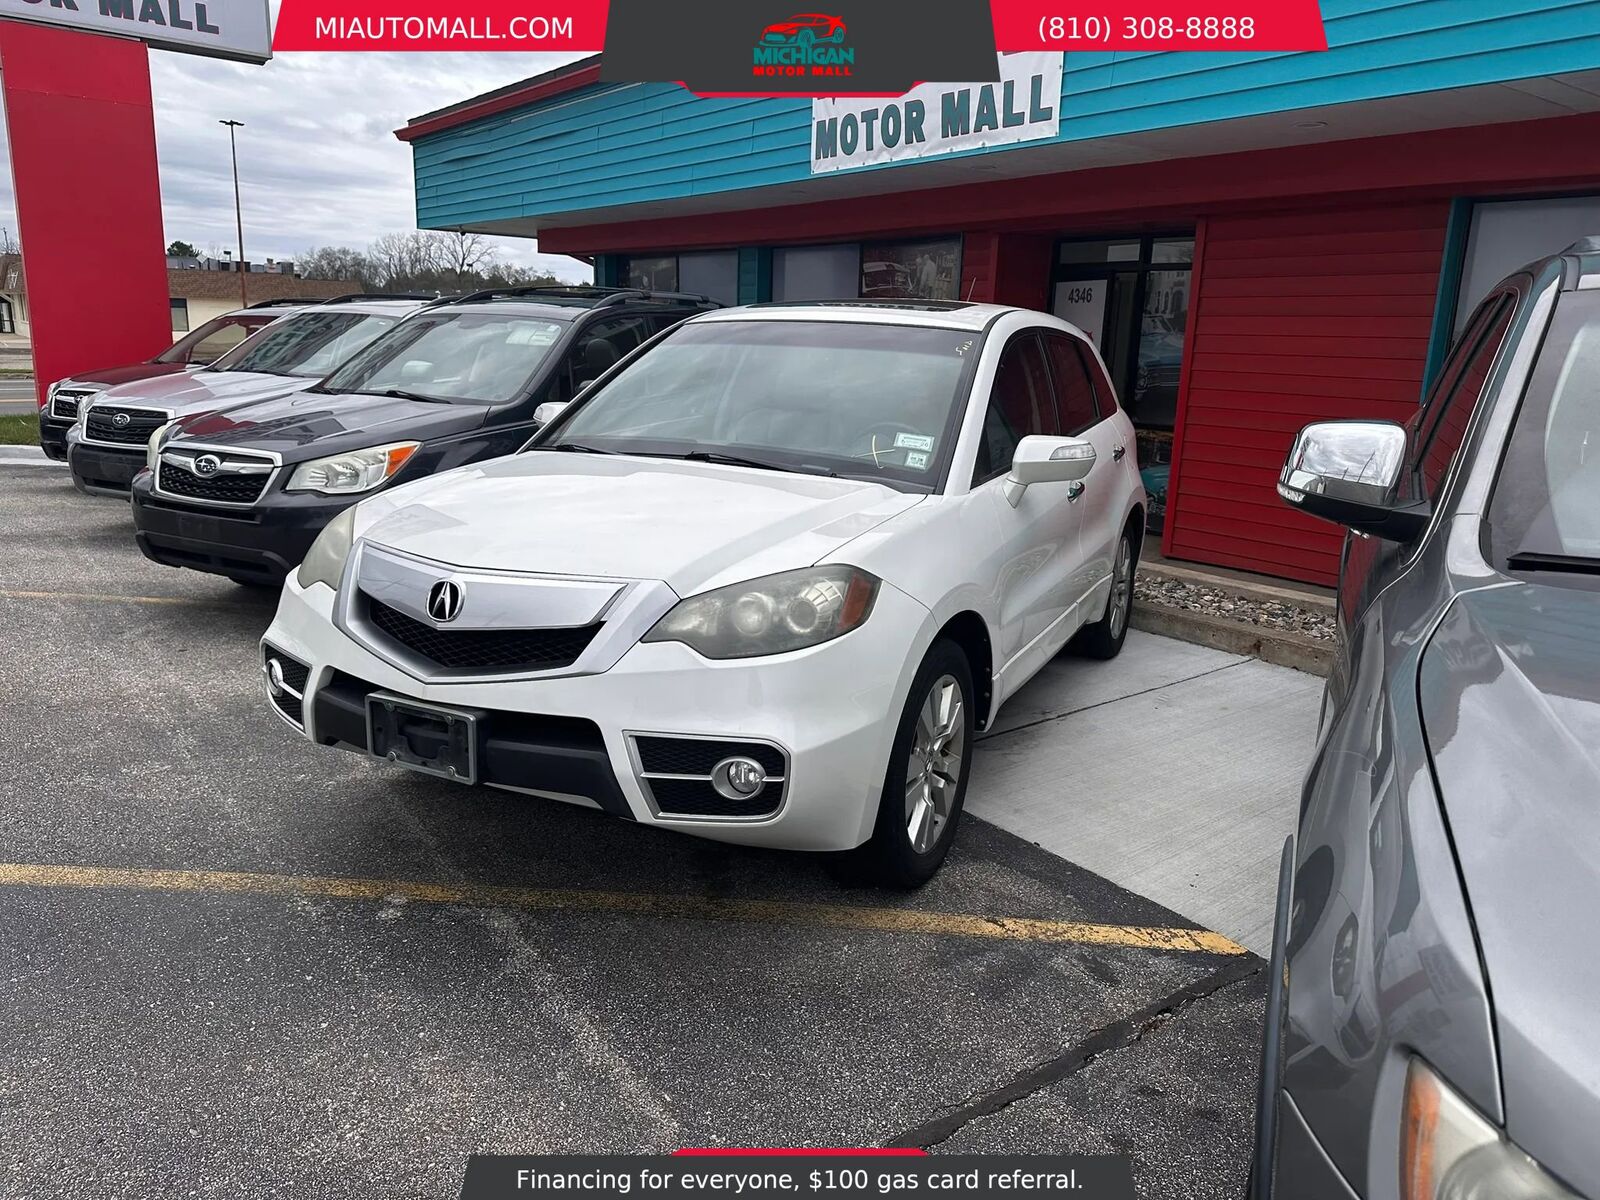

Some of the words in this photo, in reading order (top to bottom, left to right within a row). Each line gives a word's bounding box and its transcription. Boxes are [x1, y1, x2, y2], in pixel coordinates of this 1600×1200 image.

[99, 0, 220, 35] MALL
[815, 99, 926, 160] MOTOR
[941, 74, 1053, 138] MALL
[1068, 287, 1093, 304] 4346
